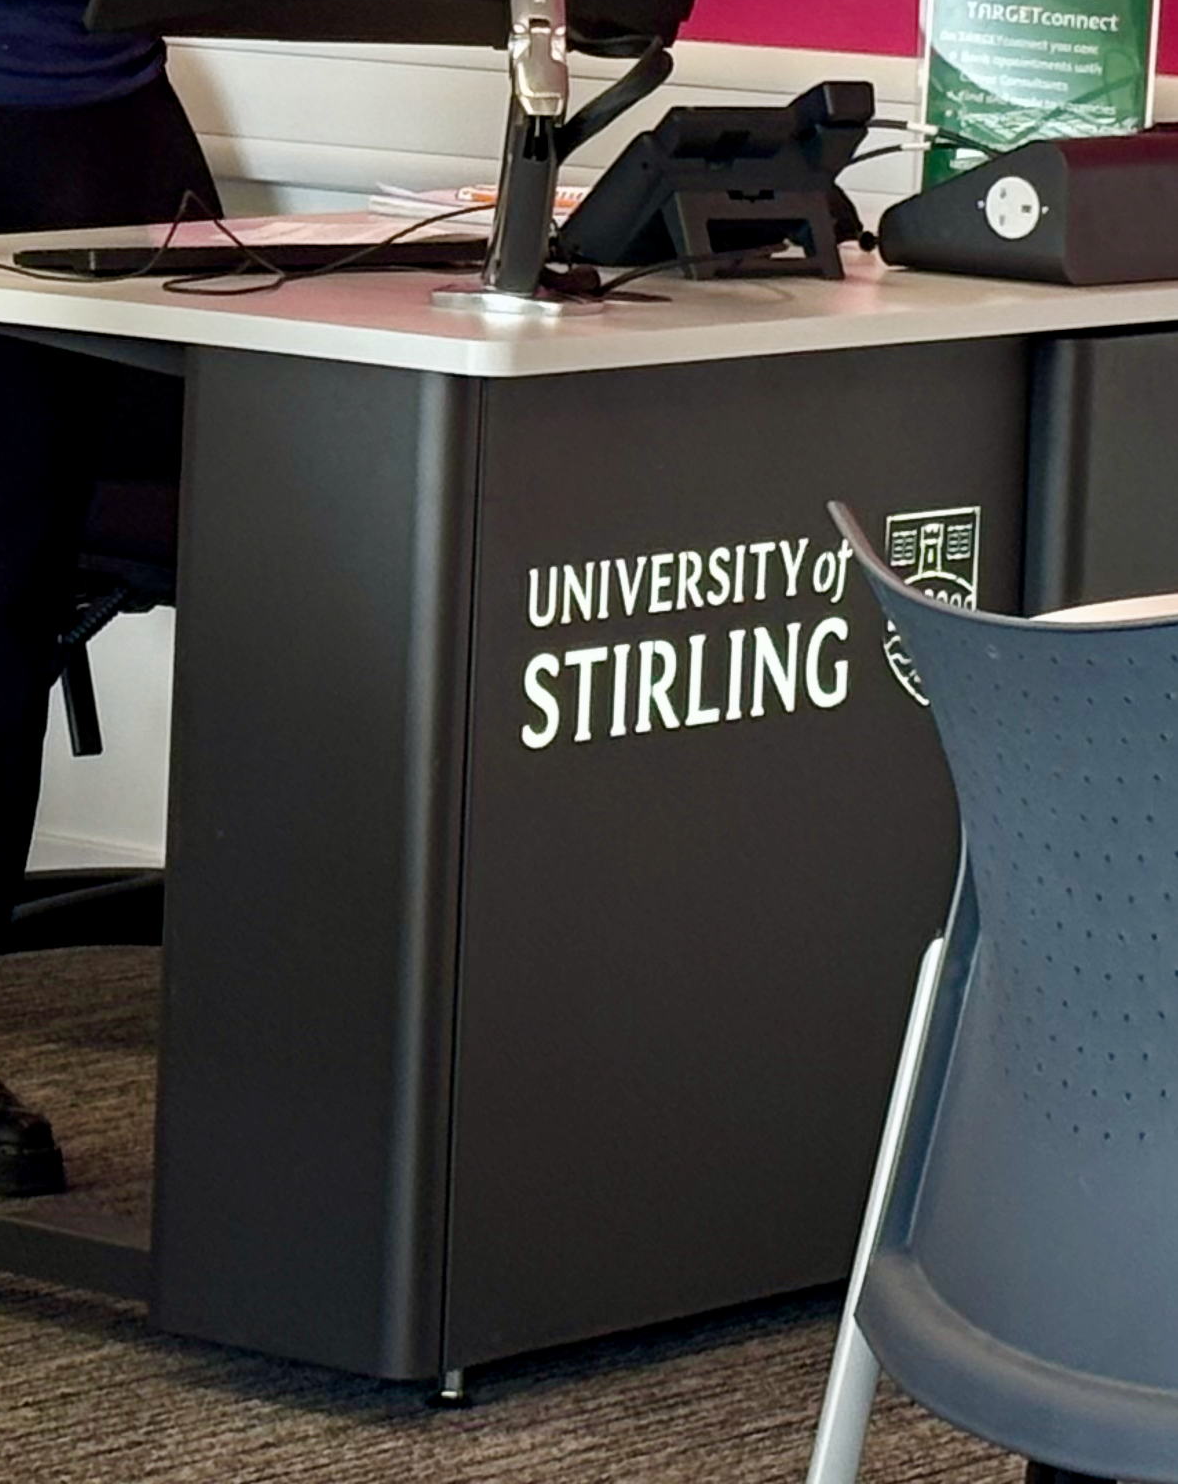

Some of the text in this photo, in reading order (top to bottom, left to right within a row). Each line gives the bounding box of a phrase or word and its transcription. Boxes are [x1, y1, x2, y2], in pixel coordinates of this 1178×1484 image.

[967, 1, 1120, 32] TARGETconnect
[528, 538, 853, 627] UNIVERSITY of
[521, 617, 848, 750] STIRLING
